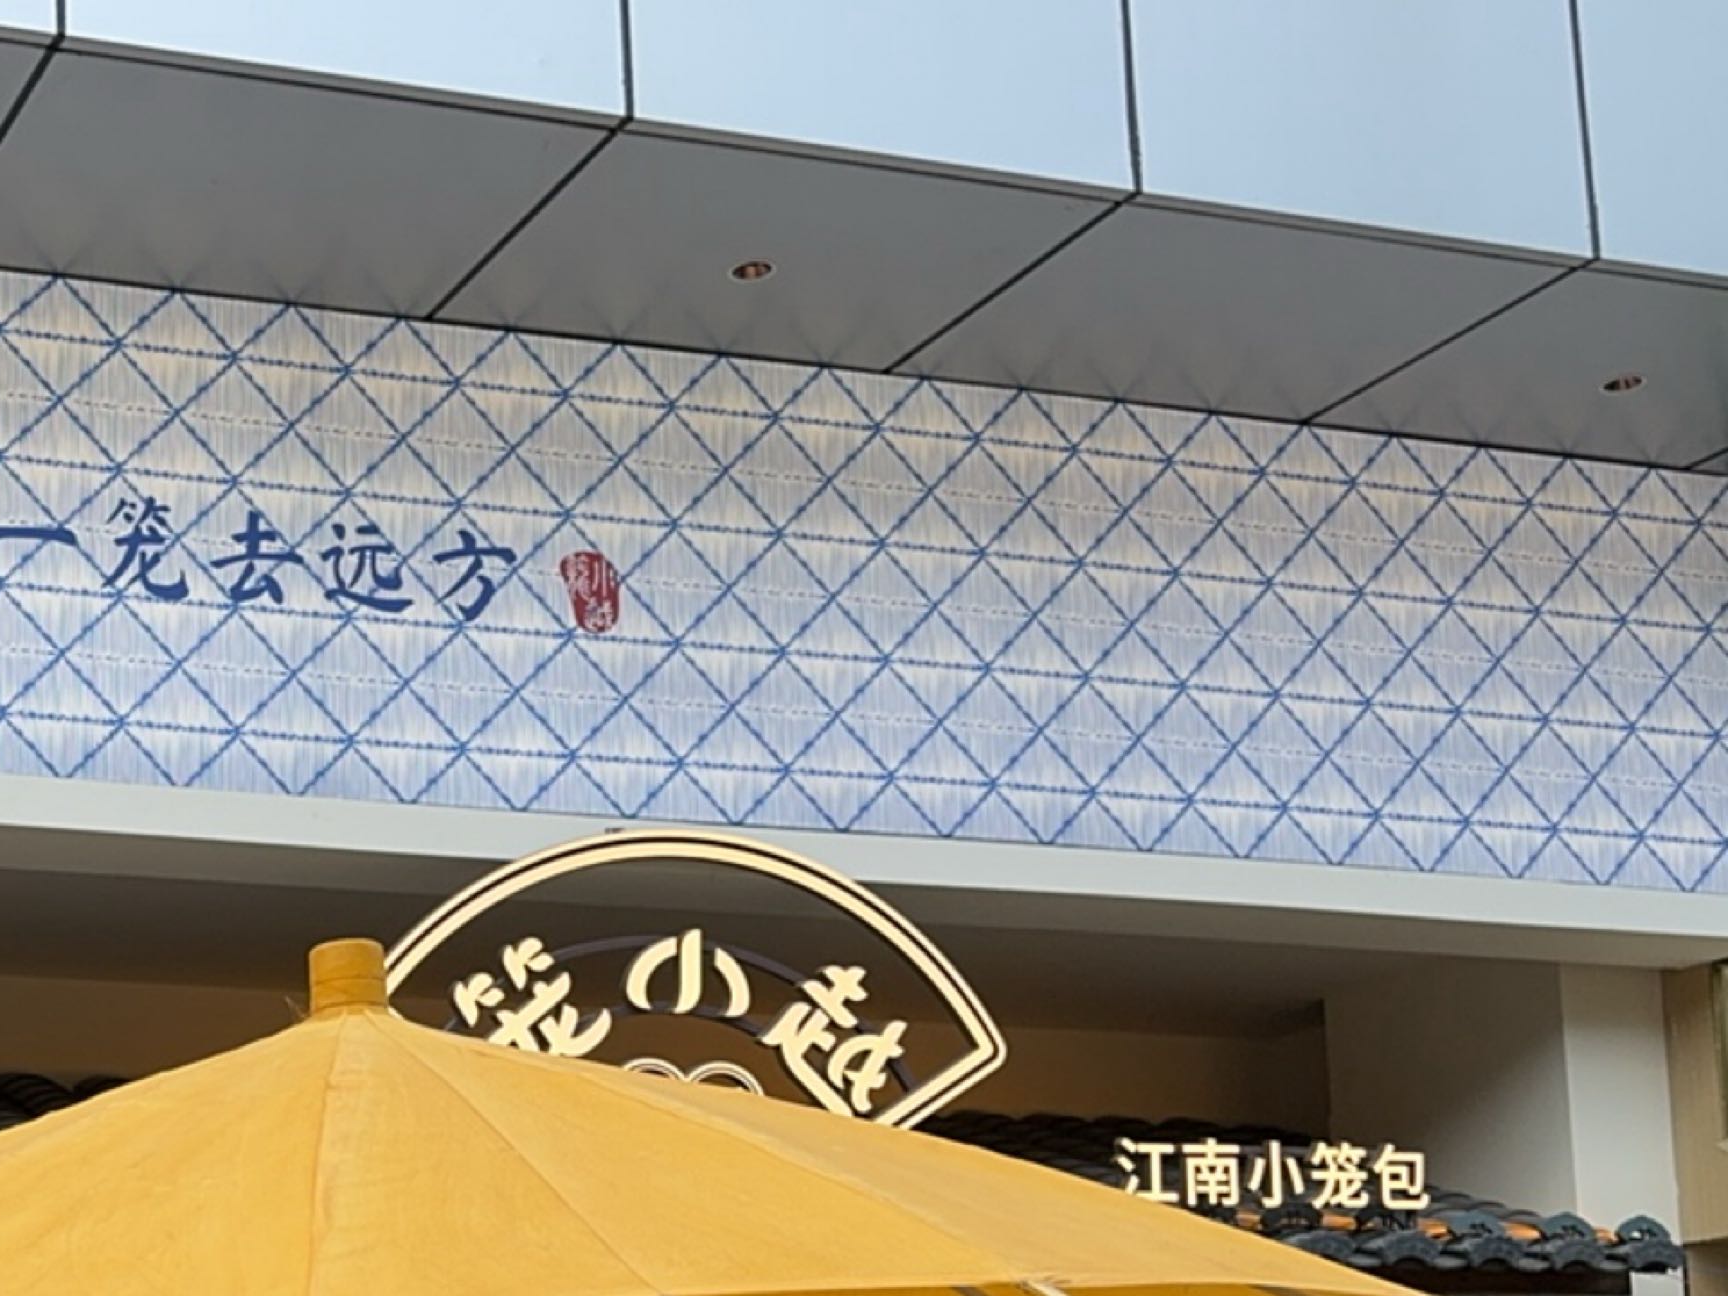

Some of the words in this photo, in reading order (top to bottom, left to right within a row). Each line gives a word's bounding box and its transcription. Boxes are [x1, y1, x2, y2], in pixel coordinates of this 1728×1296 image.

[1114, 1137, 1431, 1211] 江南小笼包
